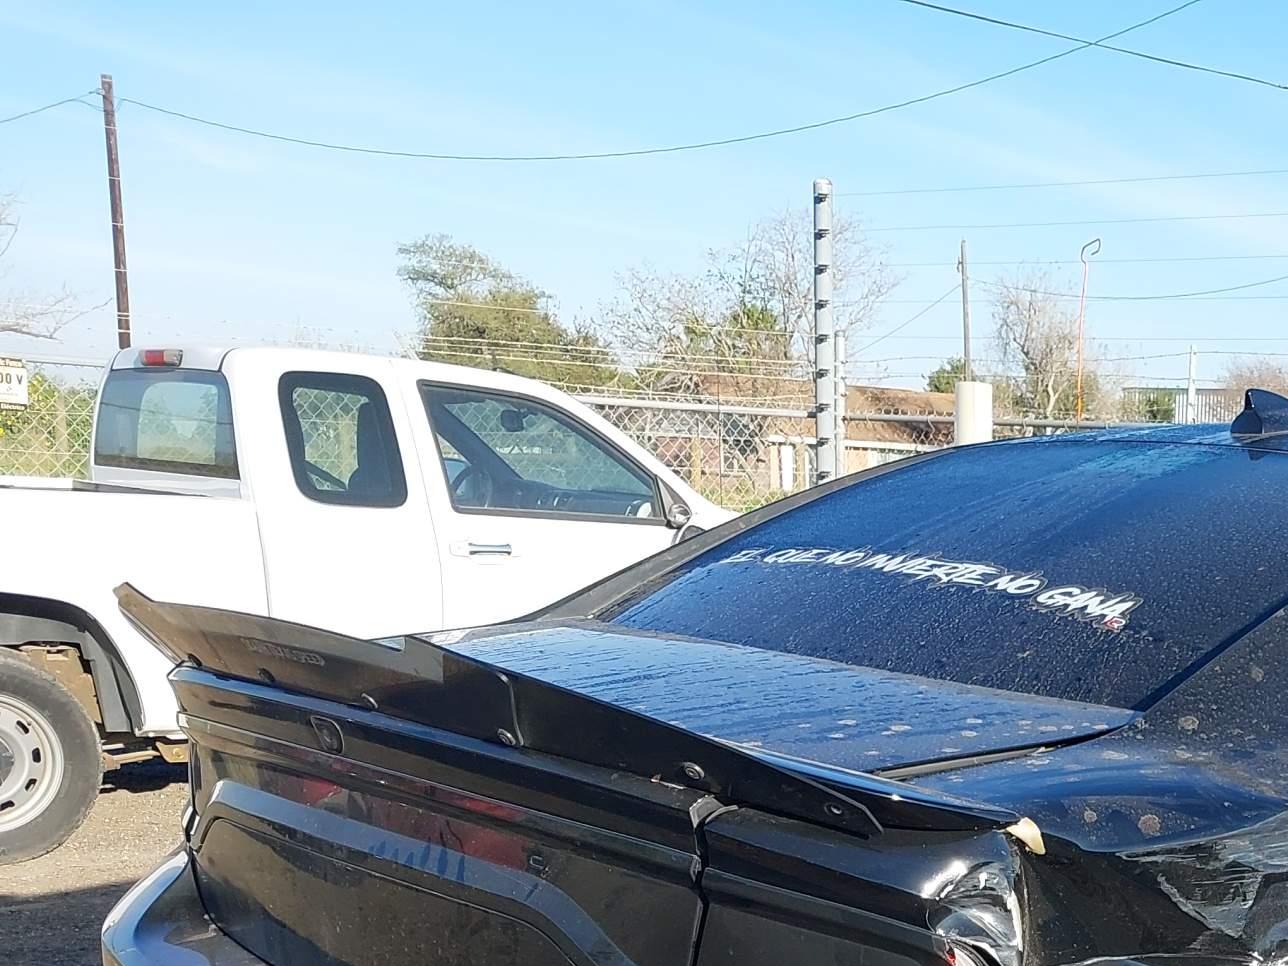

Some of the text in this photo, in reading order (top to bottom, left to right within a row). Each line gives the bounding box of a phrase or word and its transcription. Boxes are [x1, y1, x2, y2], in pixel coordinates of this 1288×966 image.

[16, 375, 23, 384] V
[719, 549, 1136, 622] EL QUE NO INVIERTE NO GANA
